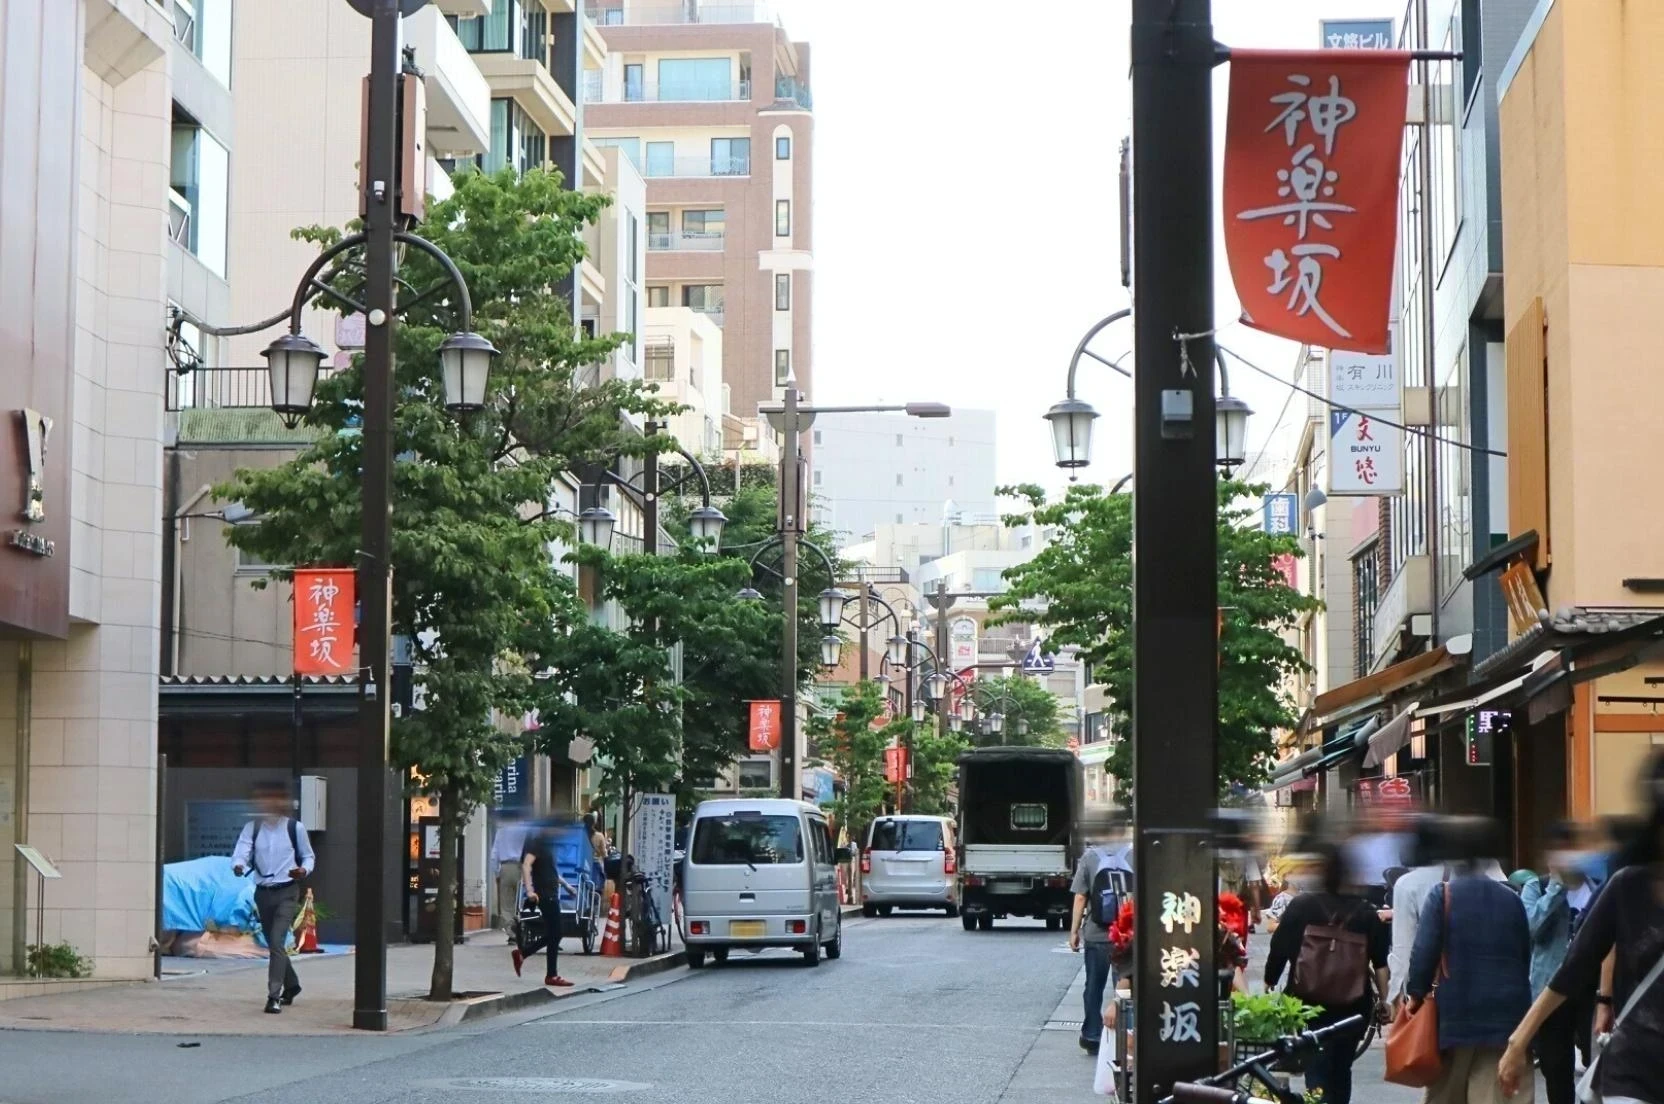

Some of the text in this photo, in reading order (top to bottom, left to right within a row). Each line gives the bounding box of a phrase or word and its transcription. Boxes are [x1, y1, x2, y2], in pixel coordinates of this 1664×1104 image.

[1327, 32, 1389, 49] 文悠ビル
[1236, 74, 1357, 339] 神楽坂
[1347, 364, 1393, 380] 有川
[1335, 412, 1348, 424] 1F
[1350, 445, 1380, 453] BUNYU
[1270, 497, 1290, 533] 歯科
[301, 577, 341, 668] 神楽坂
[752, 704, 774, 748] 神楽坂
[1160, 891, 1202, 1043] 神楽坂
